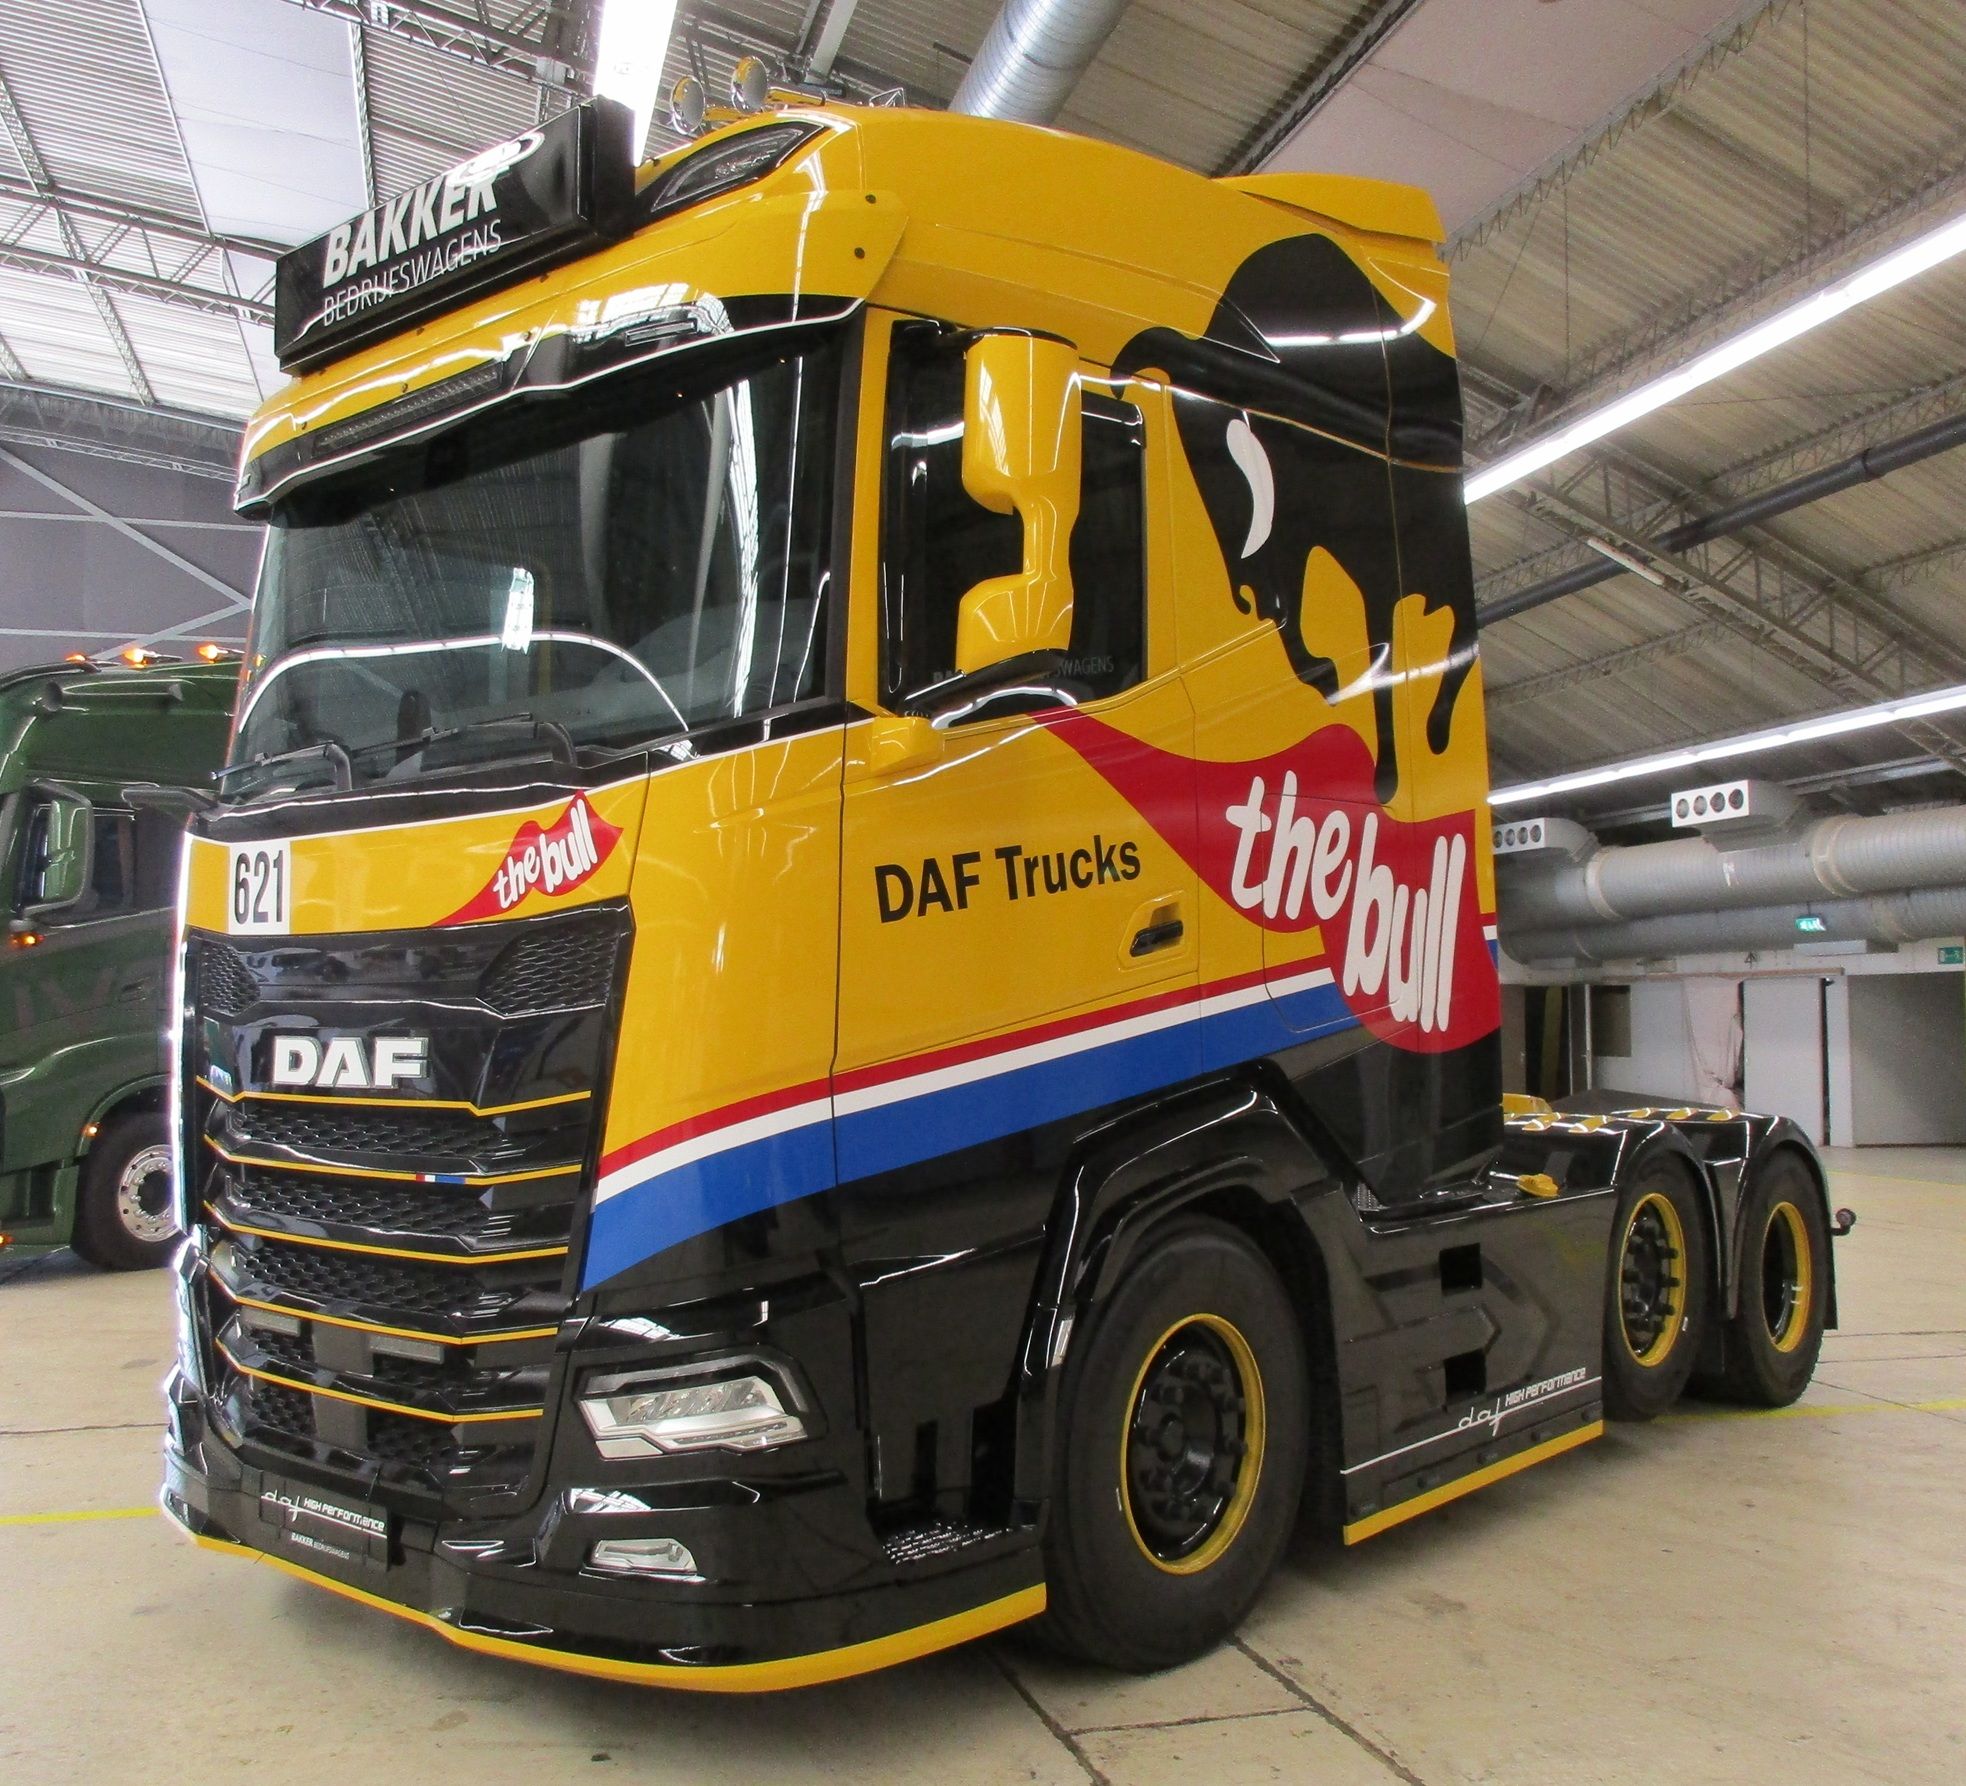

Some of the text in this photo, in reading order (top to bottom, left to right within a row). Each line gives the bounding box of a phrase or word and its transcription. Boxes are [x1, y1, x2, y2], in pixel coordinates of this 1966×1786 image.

[323, 165, 497, 288] BAKKER
[323, 219, 501, 326] BEDRIJFSWAGENS
[234, 850, 284, 924] 621
[493, 799, 598, 909] the bull
[875, 835, 1141, 923] DAF Trucks
[1225, 770, 1466, 1033] the bull
[273, 1036, 429, 1089] DAF
